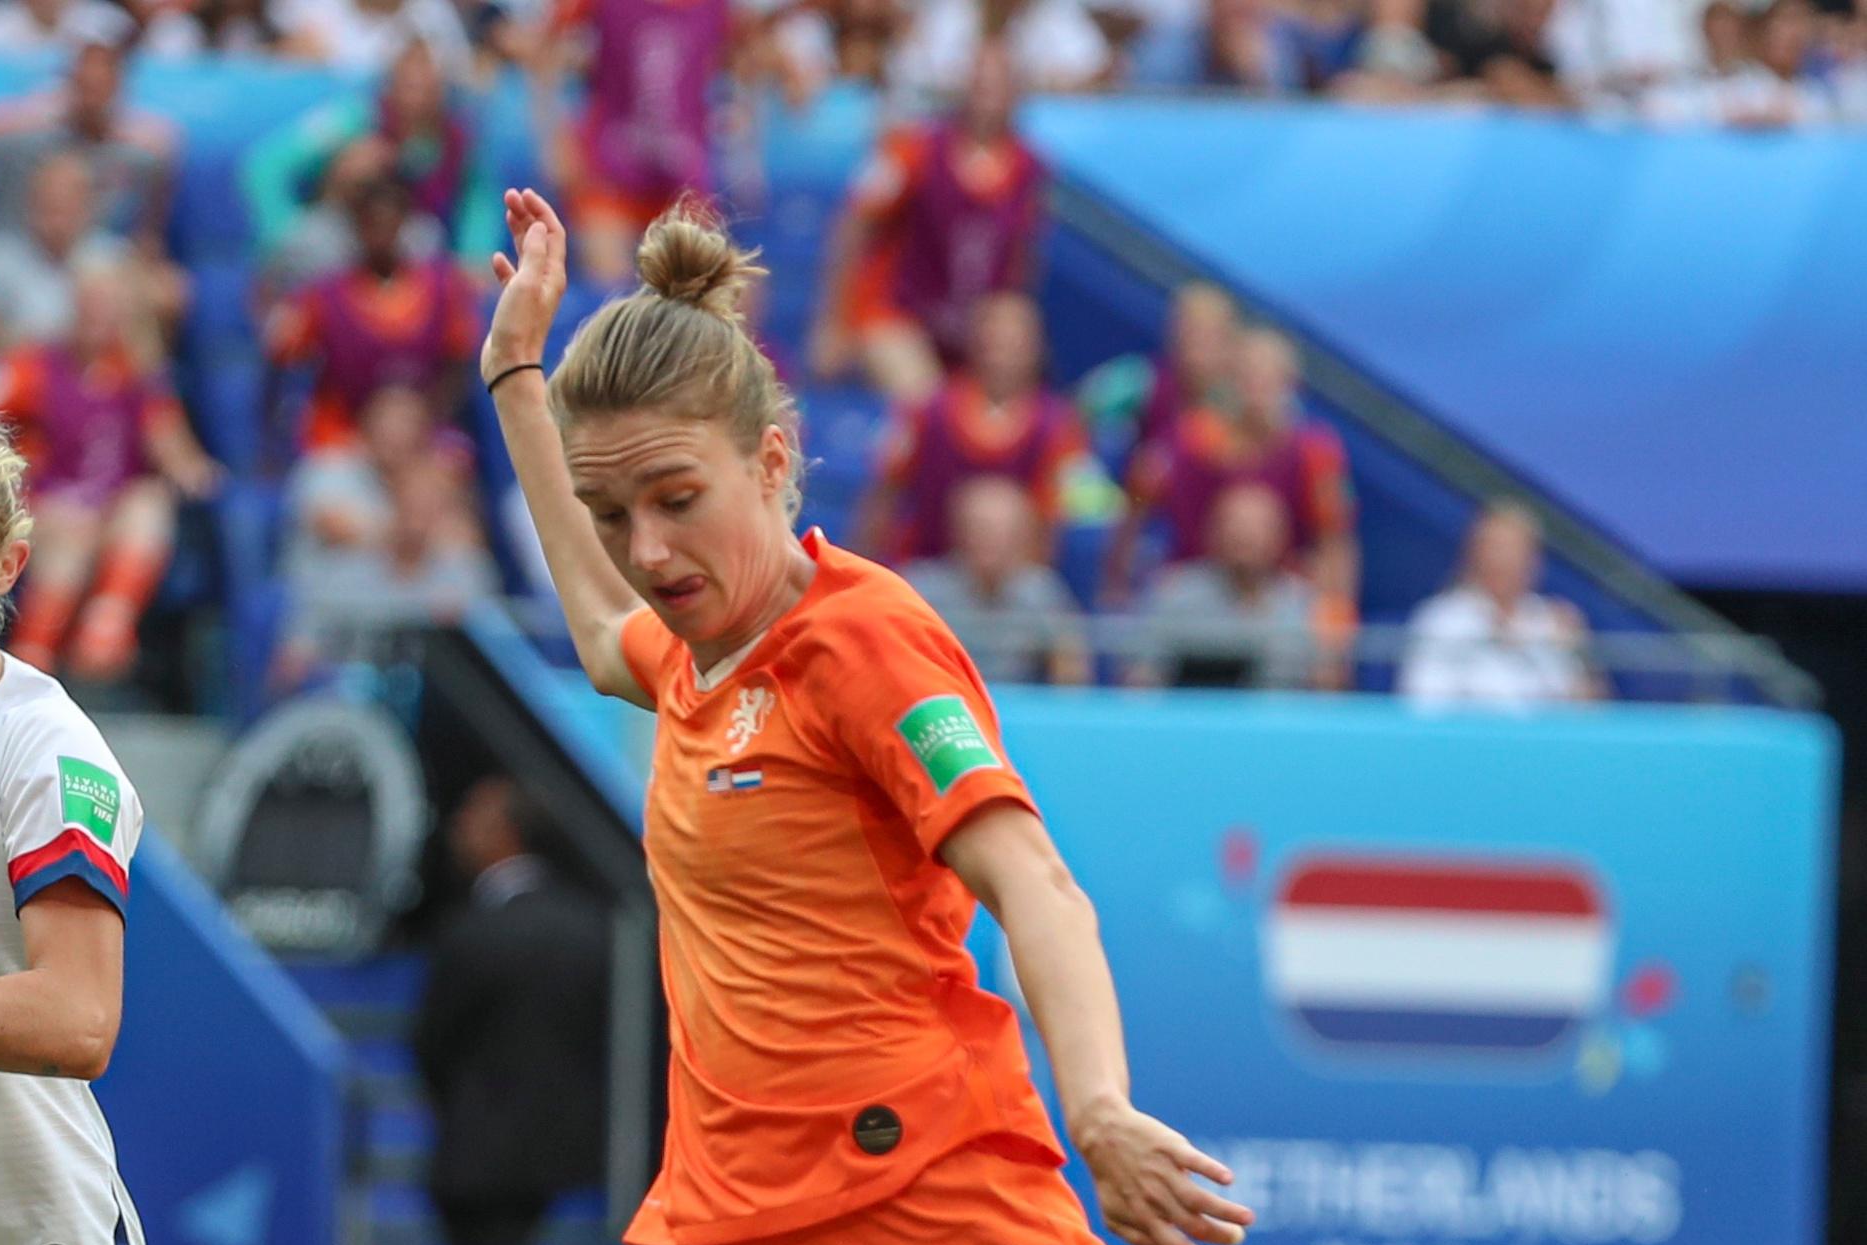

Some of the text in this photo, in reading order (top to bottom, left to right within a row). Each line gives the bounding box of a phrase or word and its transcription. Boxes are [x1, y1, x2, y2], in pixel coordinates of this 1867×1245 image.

[955, 738, 984, 750] FIFA
[64, 773, 117, 799] LIVING
[64, 781, 116, 807] FOOTBALL
[93, 805, 113, 824] FIFA
